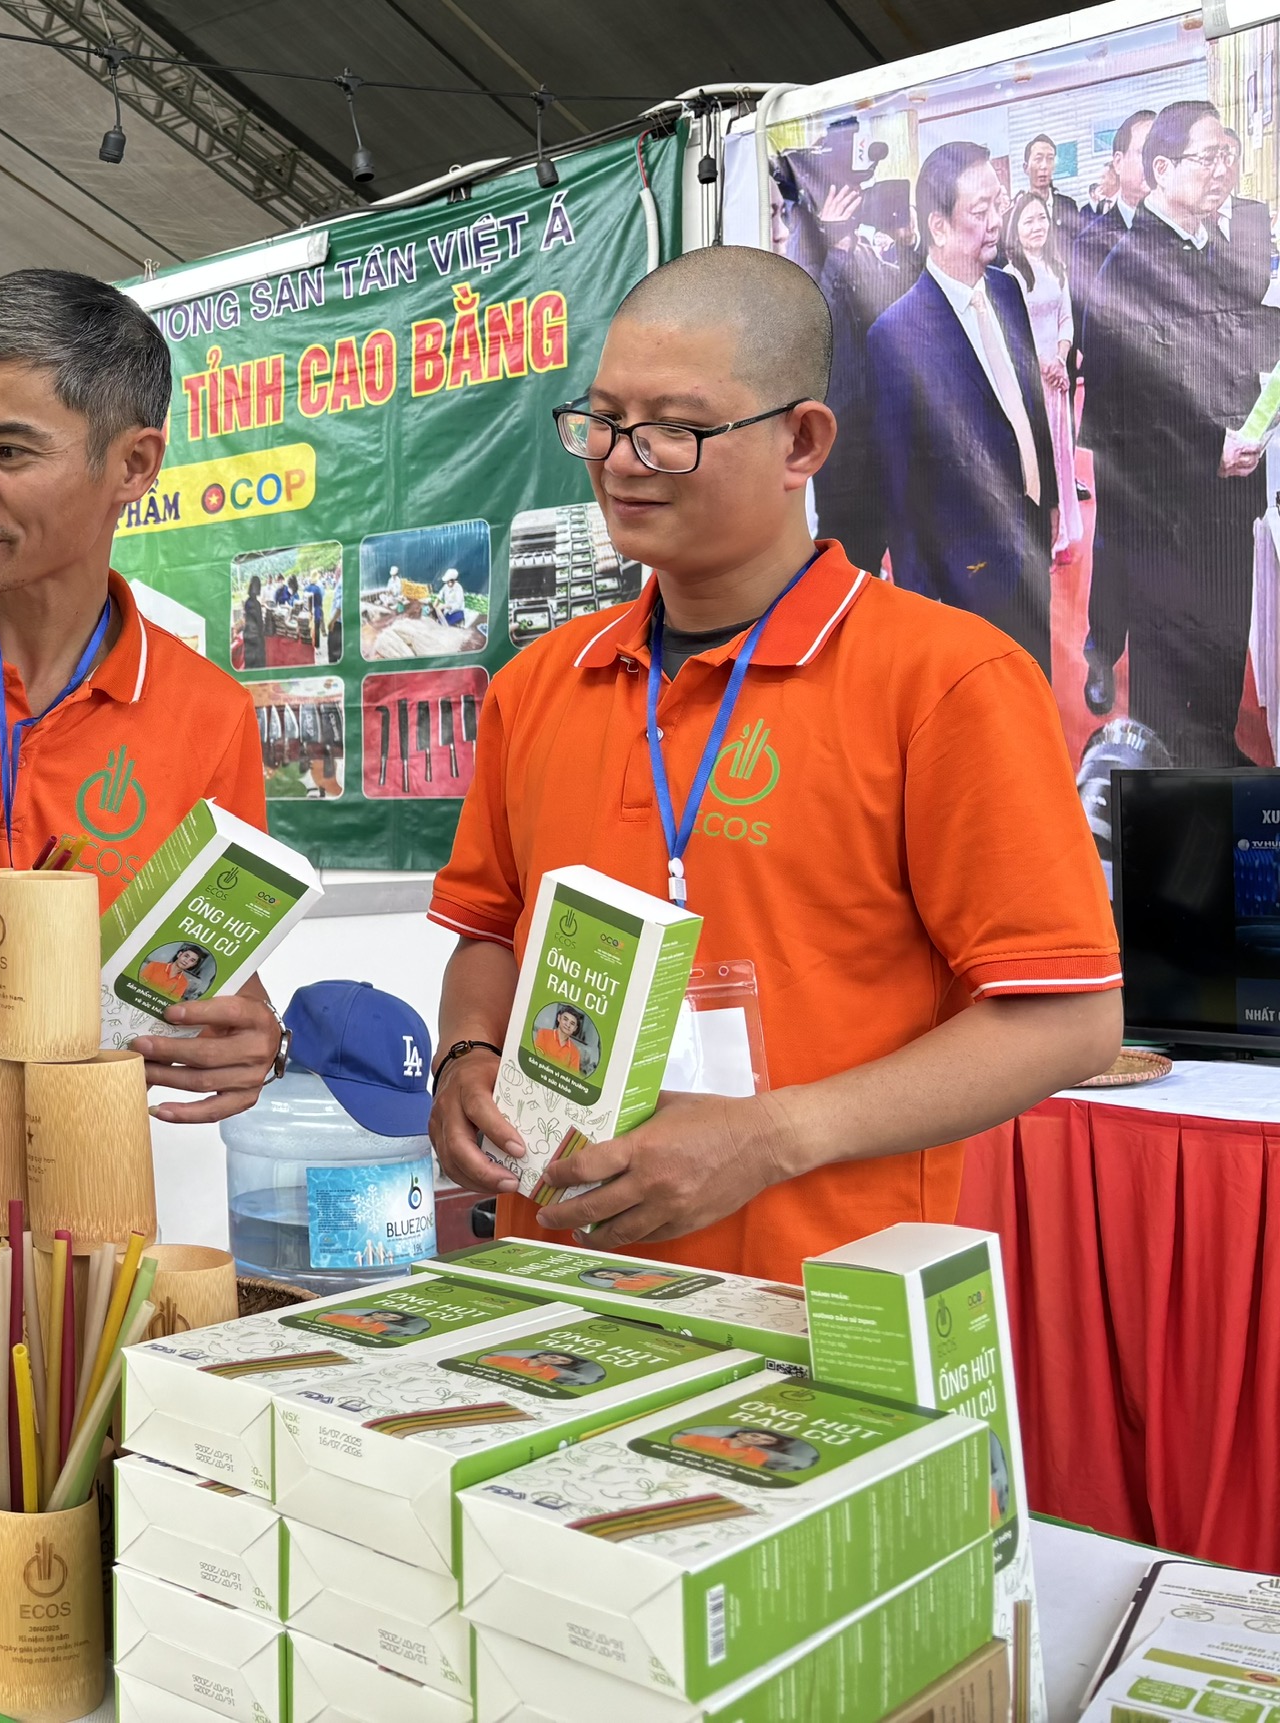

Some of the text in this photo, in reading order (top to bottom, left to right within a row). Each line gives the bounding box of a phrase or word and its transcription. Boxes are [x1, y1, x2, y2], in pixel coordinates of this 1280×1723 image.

[334, 243, 417, 299] TÂN
[427, 212, 529, 276] VIỆT
[540, 191, 576, 251] Á
[182, 282, 568, 441] TỈNH CAO BẰNG
[201, 469, 306, 514] OCOP
[205, 886, 229, 901] ECOS
[187, 895, 225, 924] ỐNG
[224, 916, 261, 943] HÚT
[178, 916, 241, 957] RAU CỦ
[554, 931, 577, 950] ECOS
[546, 946, 581, 978] ỐNG
[583, 966, 620, 996] HÚT
[546, 973, 608, 1016] RAU CỦ
[1245, 1006, 1275, 1021] NHẤT
[402, 1035, 422, 1077] LA
[538, 1063, 554, 1075] phẩm
[560, 1074, 571, 1083] môi
[386, 1211, 434, 1238] BLUEZONE
[373, 1299, 425, 1314] RAU
[442, 1301, 493, 1318] HÚT
[535, 1338, 641, 1369] RAU CỦ
[607, 1344, 669, 1365] HÚT
[939, 1346, 996, 1401] ỐNG HÚT
[978, 1380, 997, 1418] CỦ
[282, 1410, 300, 1424] NSX:
[728, 1411, 851, 1447] RAU CỦ
[737, 1400, 883, 1441] ỐNG HÚT
[482, 1484, 526, 1501] FDA
[20, 1601, 71, 1619] ECOS
